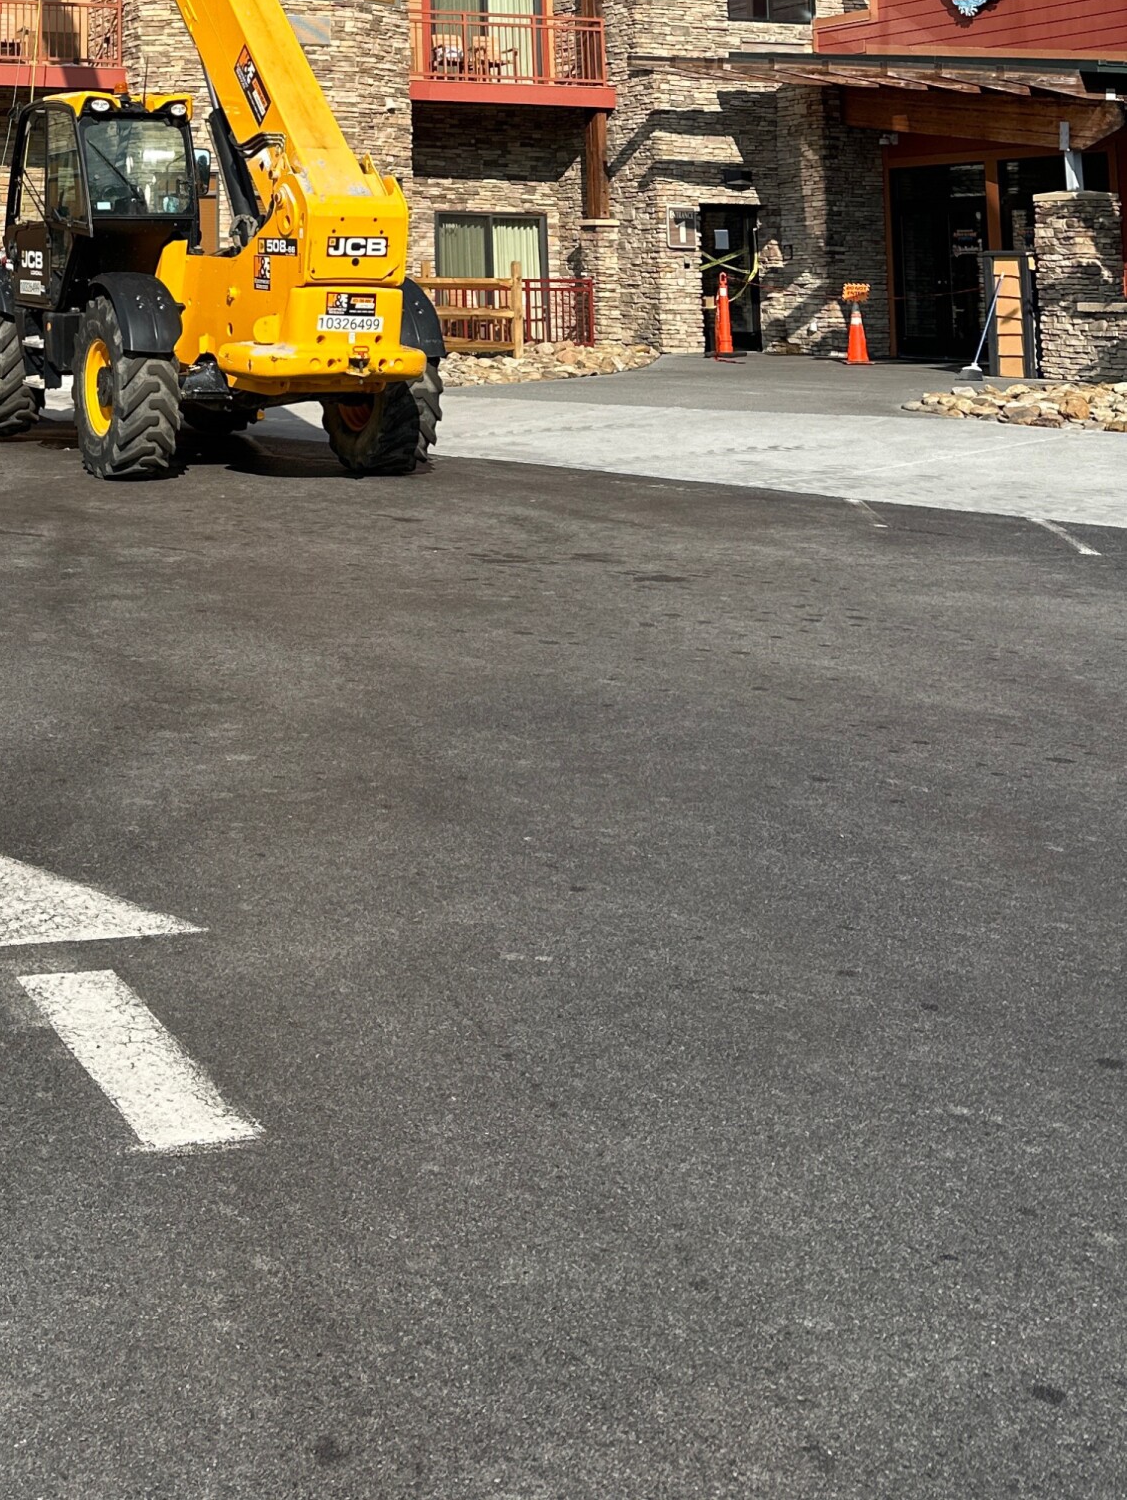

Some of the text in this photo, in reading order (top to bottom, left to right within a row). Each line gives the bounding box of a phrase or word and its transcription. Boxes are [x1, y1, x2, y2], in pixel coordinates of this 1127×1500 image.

[670, 210, 694, 219] ENTRANCE
[675, 221, 687, 243] 1
[328, 238, 387, 256] JCB
[21, 250, 43, 269] JCB
[318, 317, 380, 331] 10326499
